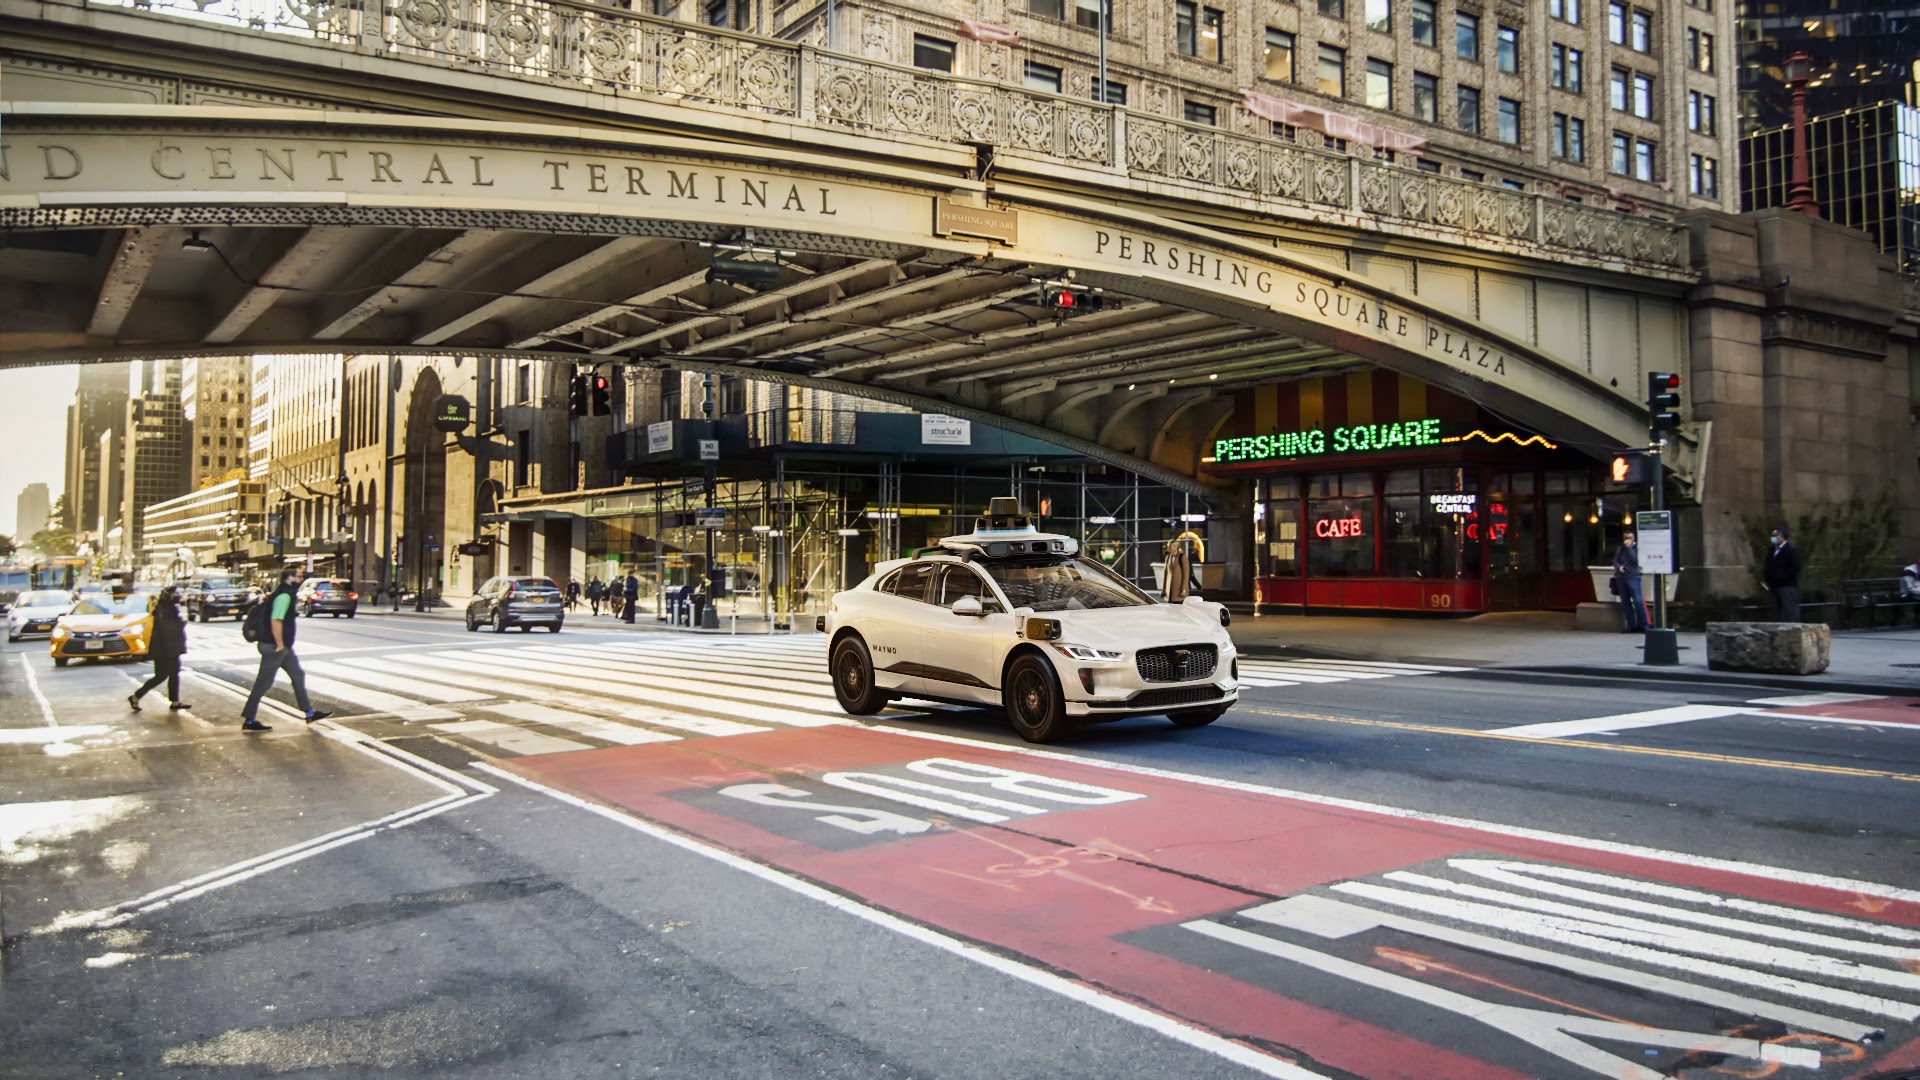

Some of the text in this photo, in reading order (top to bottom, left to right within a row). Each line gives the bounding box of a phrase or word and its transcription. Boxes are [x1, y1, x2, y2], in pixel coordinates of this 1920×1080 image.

[151, 145, 495, 187] CENTRAL
[543, 160, 837, 216] TERMINAL
[942, 212, 1014, 230] PERSHING SQUARE
[1095, 231, 1506, 376] PERSHING SQUARE PLAZA
[1215, 418, 1441, 462] PERSHING SQUARE
[1430, 494, 1476, 504] BREAKFAST
[1436, 504, 1472, 513] CENTRAL
[1431, 594, 1451, 608] 90
[872, 644, 897, 655] WAYMO
[718, 757, 1147, 835] BUS
